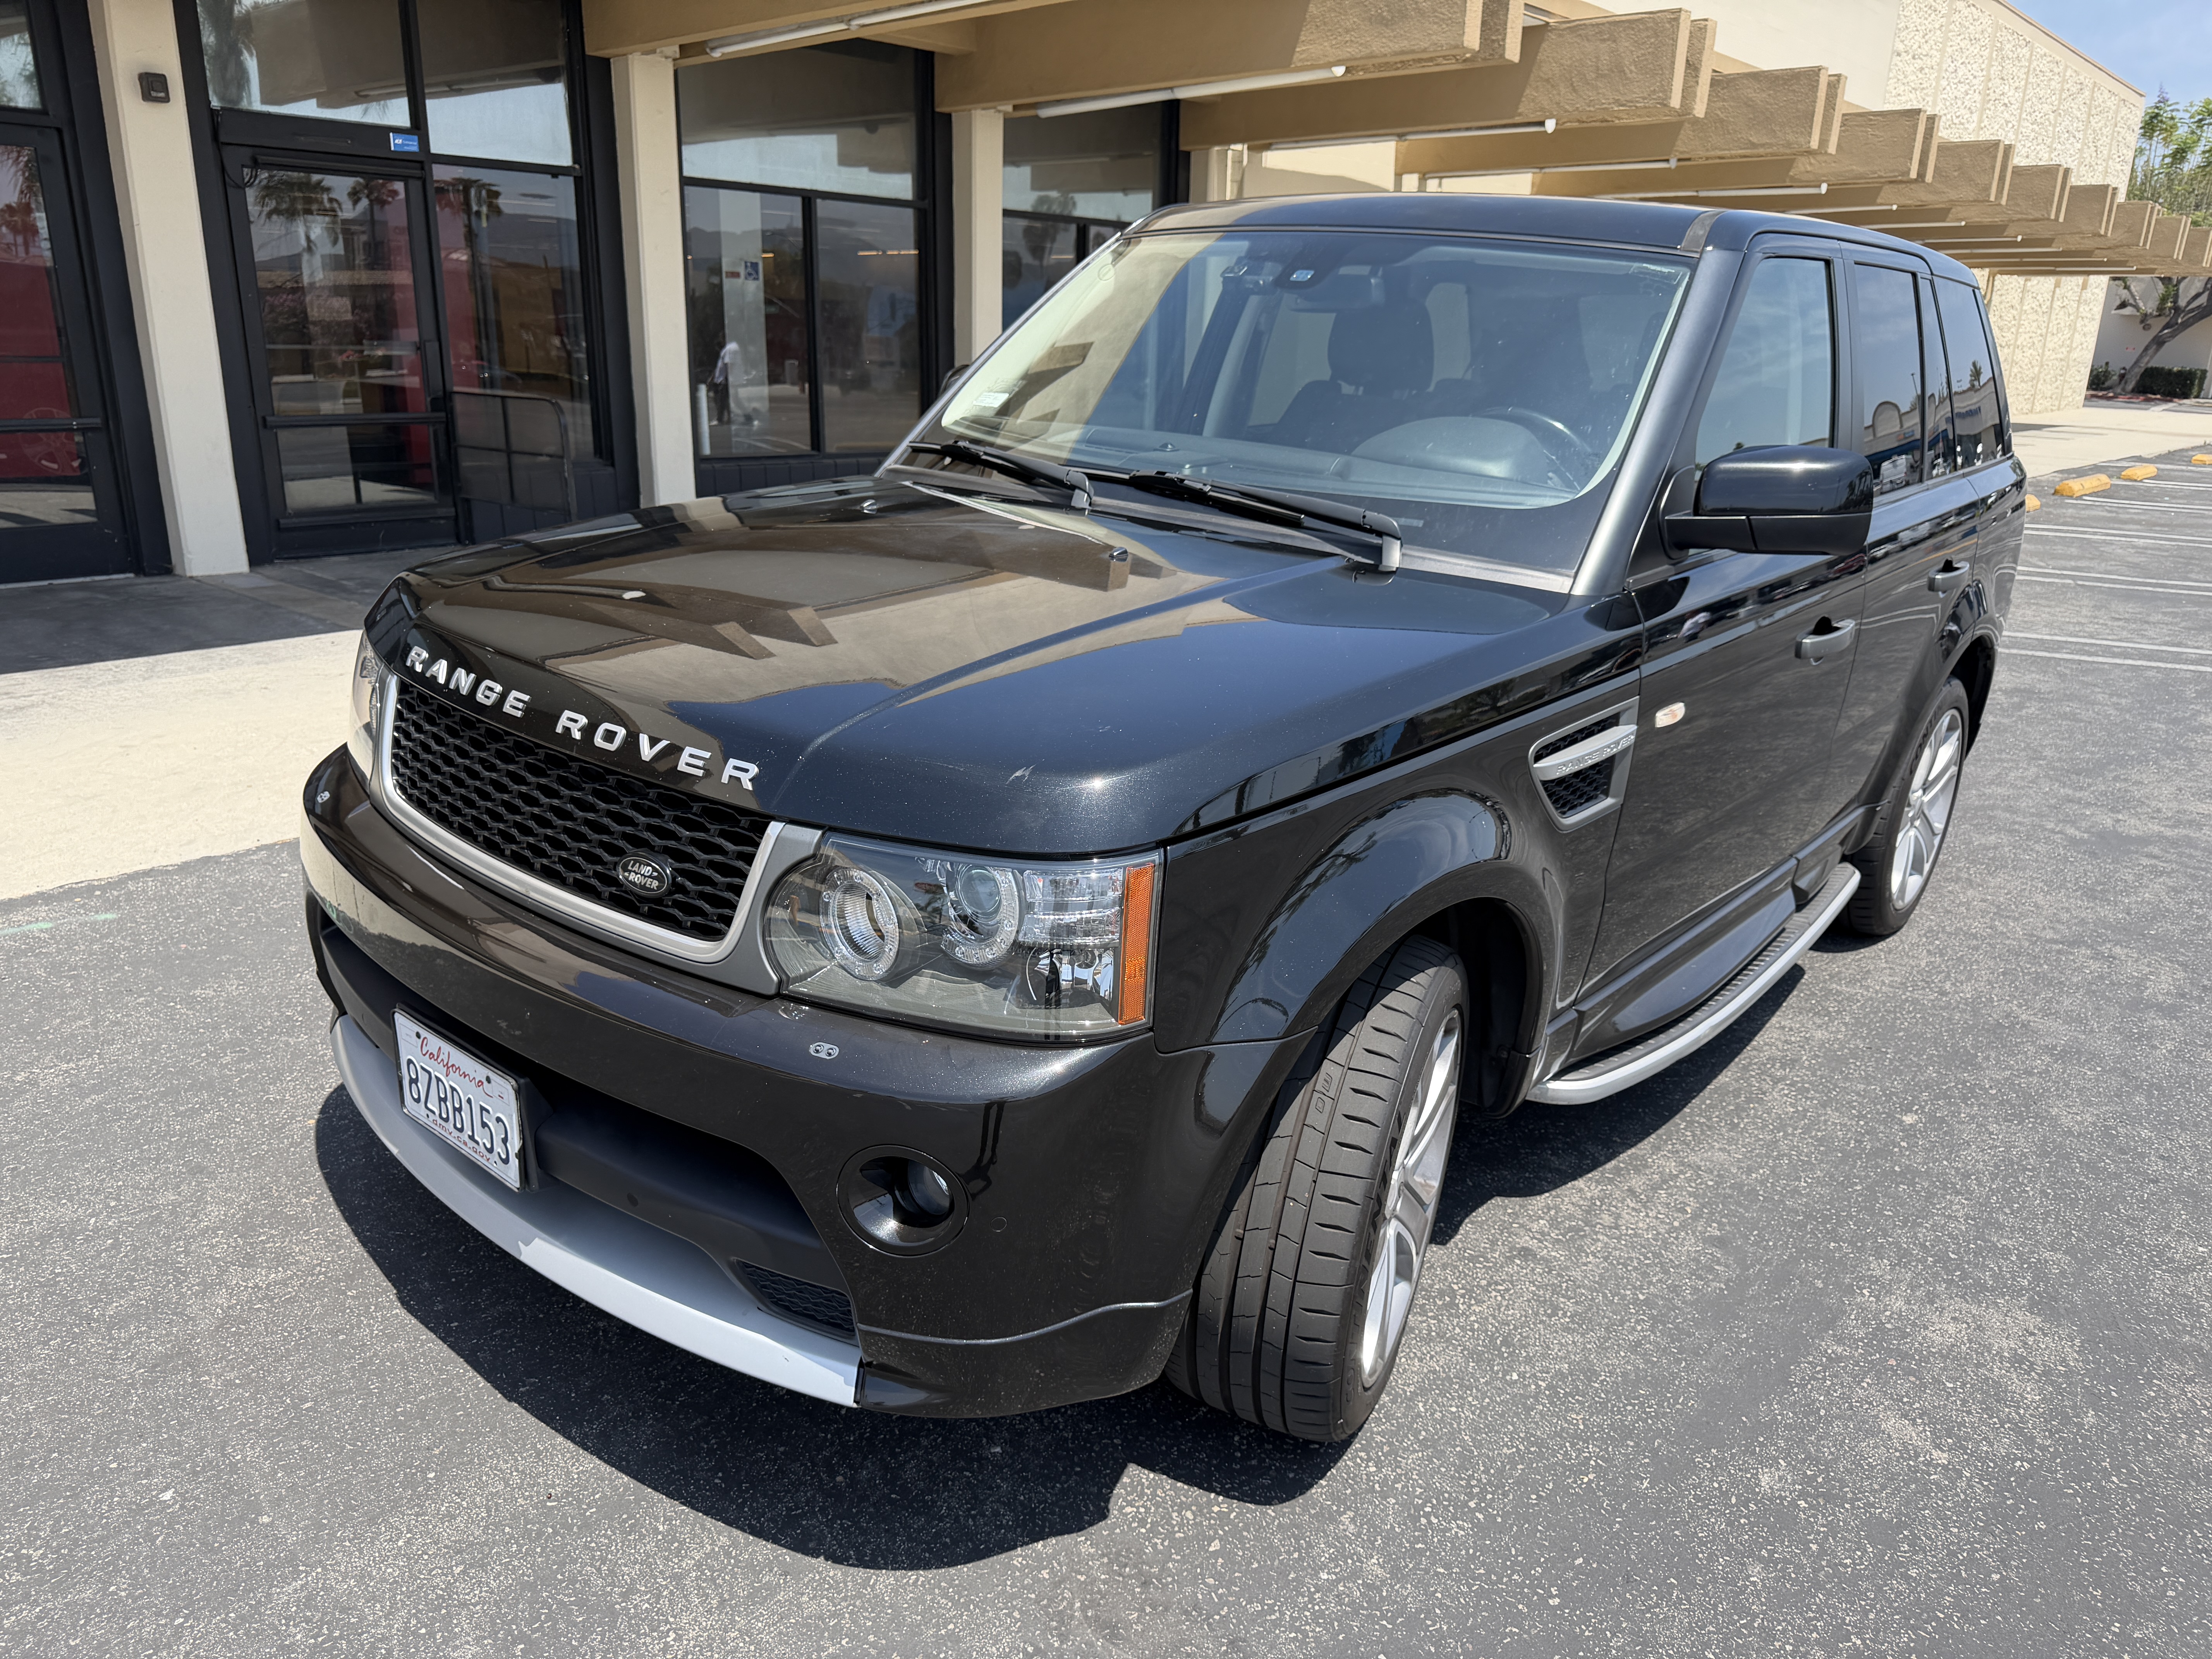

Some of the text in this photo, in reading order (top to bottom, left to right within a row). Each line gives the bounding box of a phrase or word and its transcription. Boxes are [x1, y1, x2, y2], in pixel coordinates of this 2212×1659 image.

[406, 645, 759, 791] RANGE ROVER
[1556, 733, 1635, 775] RANGE ROVER
[628, 860, 653, 876] LAND
[628, 872, 659, 890] ROVER
[420, 1036, 493, 1098] California
[407, 1056, 511, 1165] 8ZBB153
[432, 1118, 491, 1162] dmv.ca.gov
[1346, 1110, 1407, 1403] CONTINENTAL
